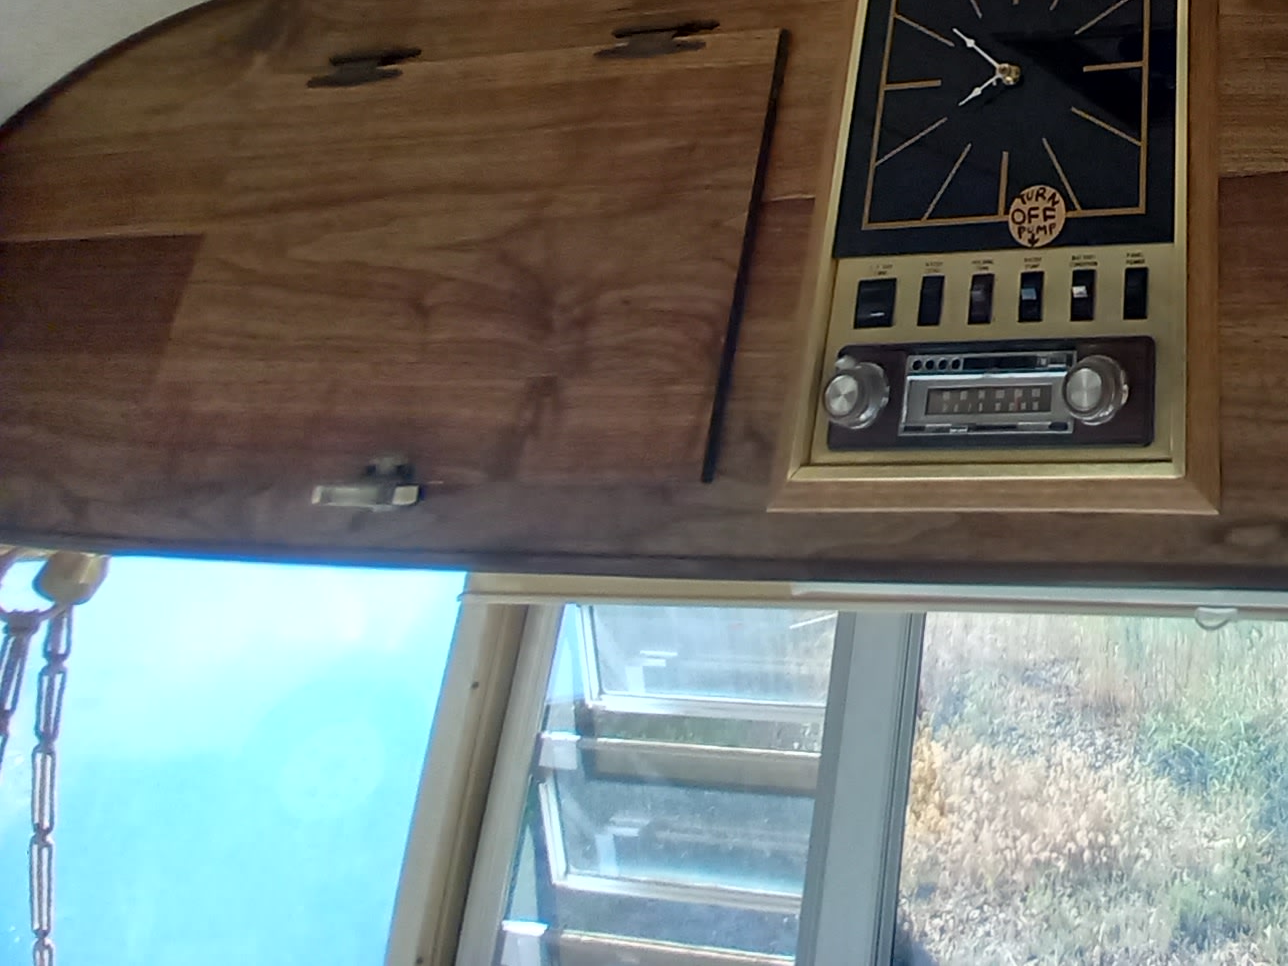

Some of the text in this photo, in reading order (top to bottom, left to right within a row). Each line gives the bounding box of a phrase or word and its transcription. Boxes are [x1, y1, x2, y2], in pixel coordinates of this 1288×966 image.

[1013, 187, 1060, 207] TURN
[1011, 206, 1056, 225] OFF
[1017, 223, 1056, 240] PUMP
